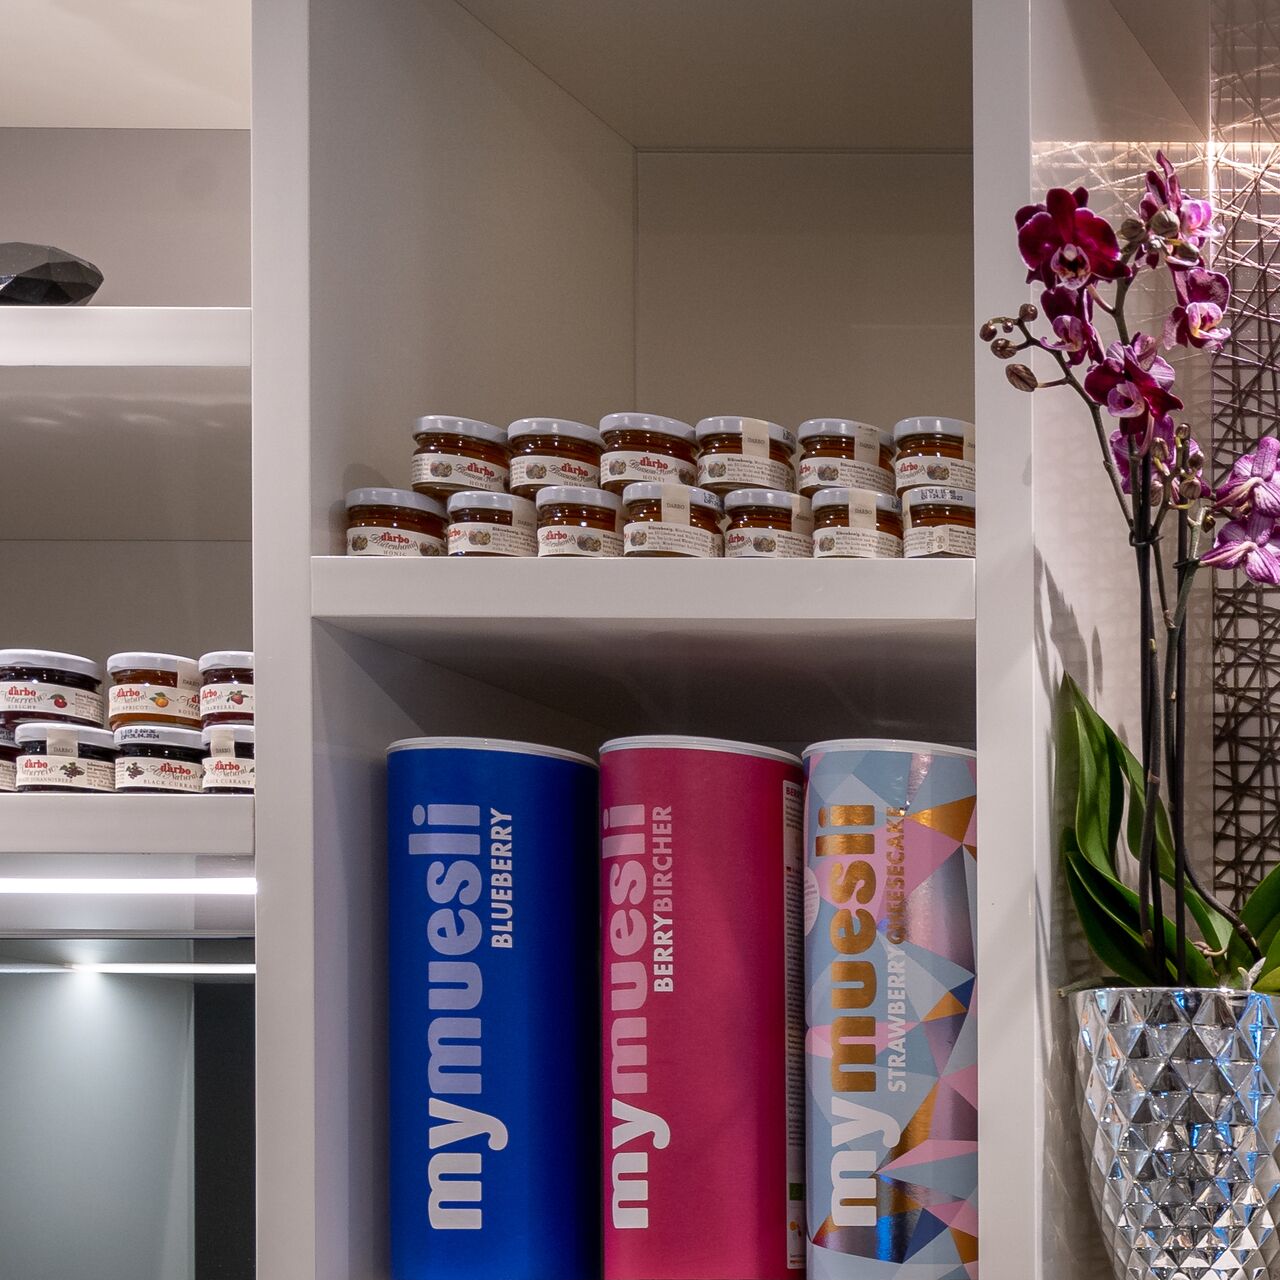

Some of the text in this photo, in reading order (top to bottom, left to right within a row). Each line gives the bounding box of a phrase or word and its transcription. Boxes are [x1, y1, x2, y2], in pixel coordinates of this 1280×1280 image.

[408, 804, 509, 1229] mymuesli
[490, 808, 513, 949] BLUEBERRY
[602, 804, 671, 1229] mymuesli
[815, 804, 901, 1227] mymuesli
